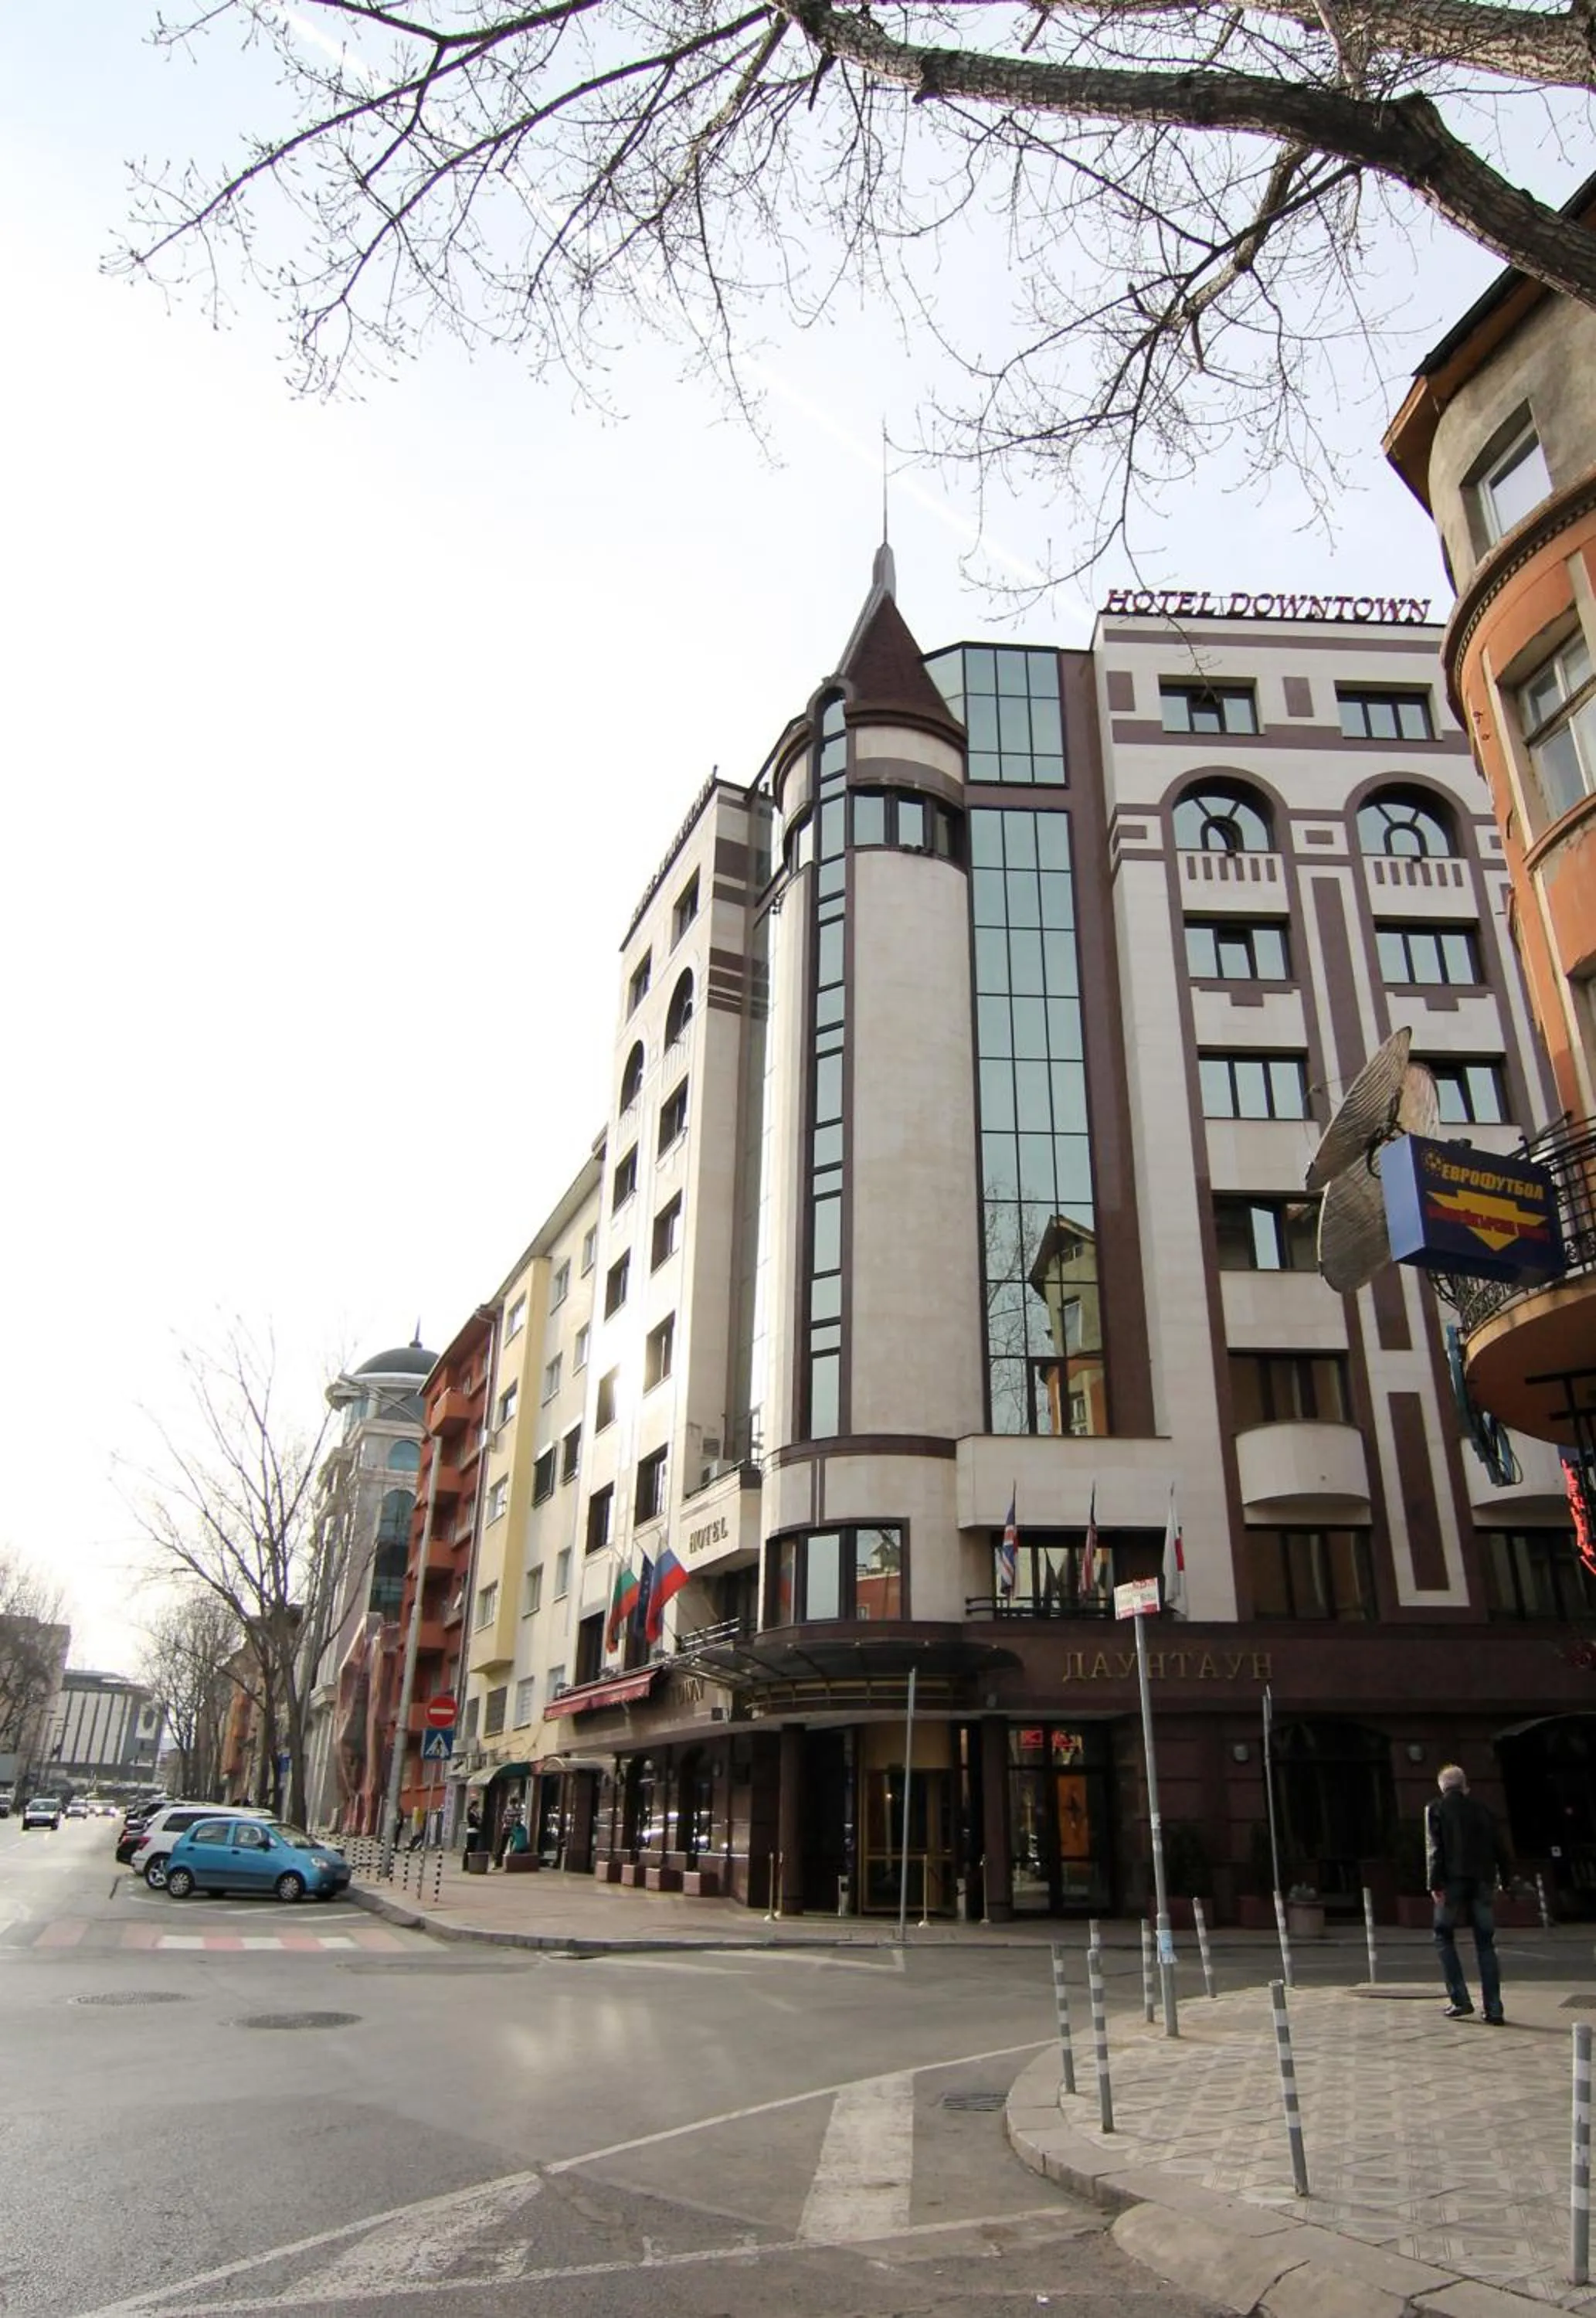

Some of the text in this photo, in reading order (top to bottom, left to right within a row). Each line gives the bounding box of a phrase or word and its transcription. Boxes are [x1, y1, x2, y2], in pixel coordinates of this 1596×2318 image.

[1103, 590, 1432, 623] HOTEL DOWNTOWN
[1441, 1164, 1543, 1200] ЕВРОФУТБОЛ
[689, 1517, 729, 1554] HOTEL
[1062, 1652, 1272, 1681] ДАУНТАУН
